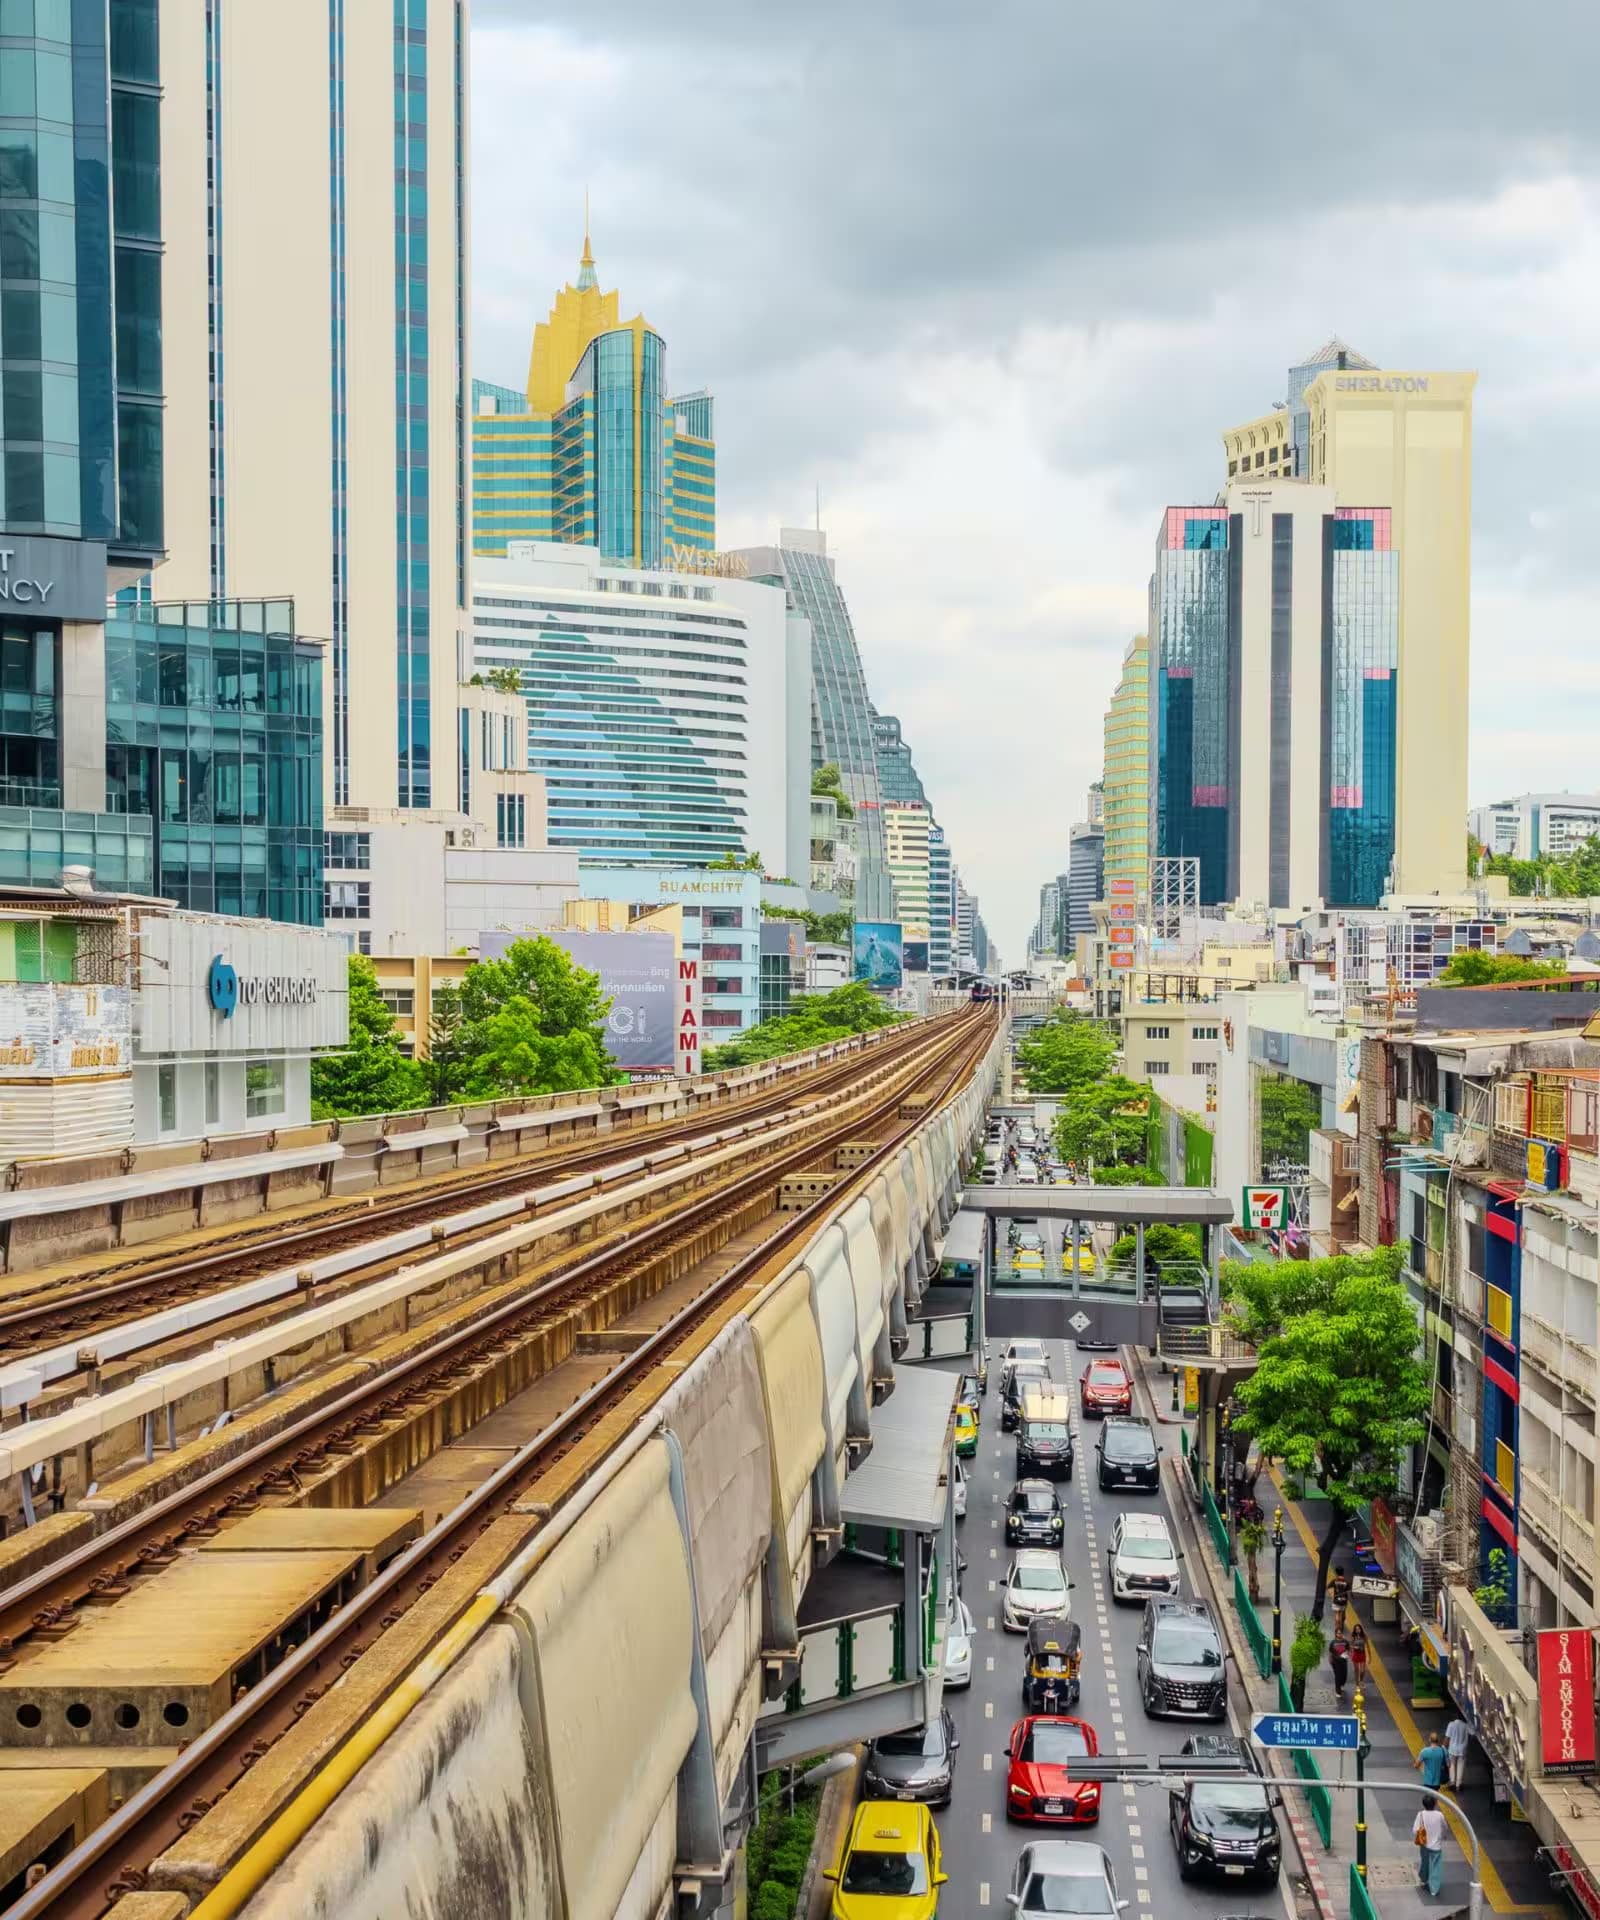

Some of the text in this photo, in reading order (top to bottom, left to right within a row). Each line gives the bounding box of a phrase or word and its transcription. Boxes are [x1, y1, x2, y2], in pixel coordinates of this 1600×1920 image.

[1335, 376, 1429, 393] SHERATON
[672, 543, 747, 571] WESTIN
[660, 881, 743, 893] RUAMCHITT
[239, 976, 319, 1005] TOP CHAROEN
[680, 961, 697, 1074] MIAMI
[1253, 1193, 1278, 1228] 7
[1558, 1633, 1575, 1759] SIAM EMPORIUM
[1273, 1719, 1319, 1736] สุขุมวิท
[1342, 1724, 1352, 1736] 11
